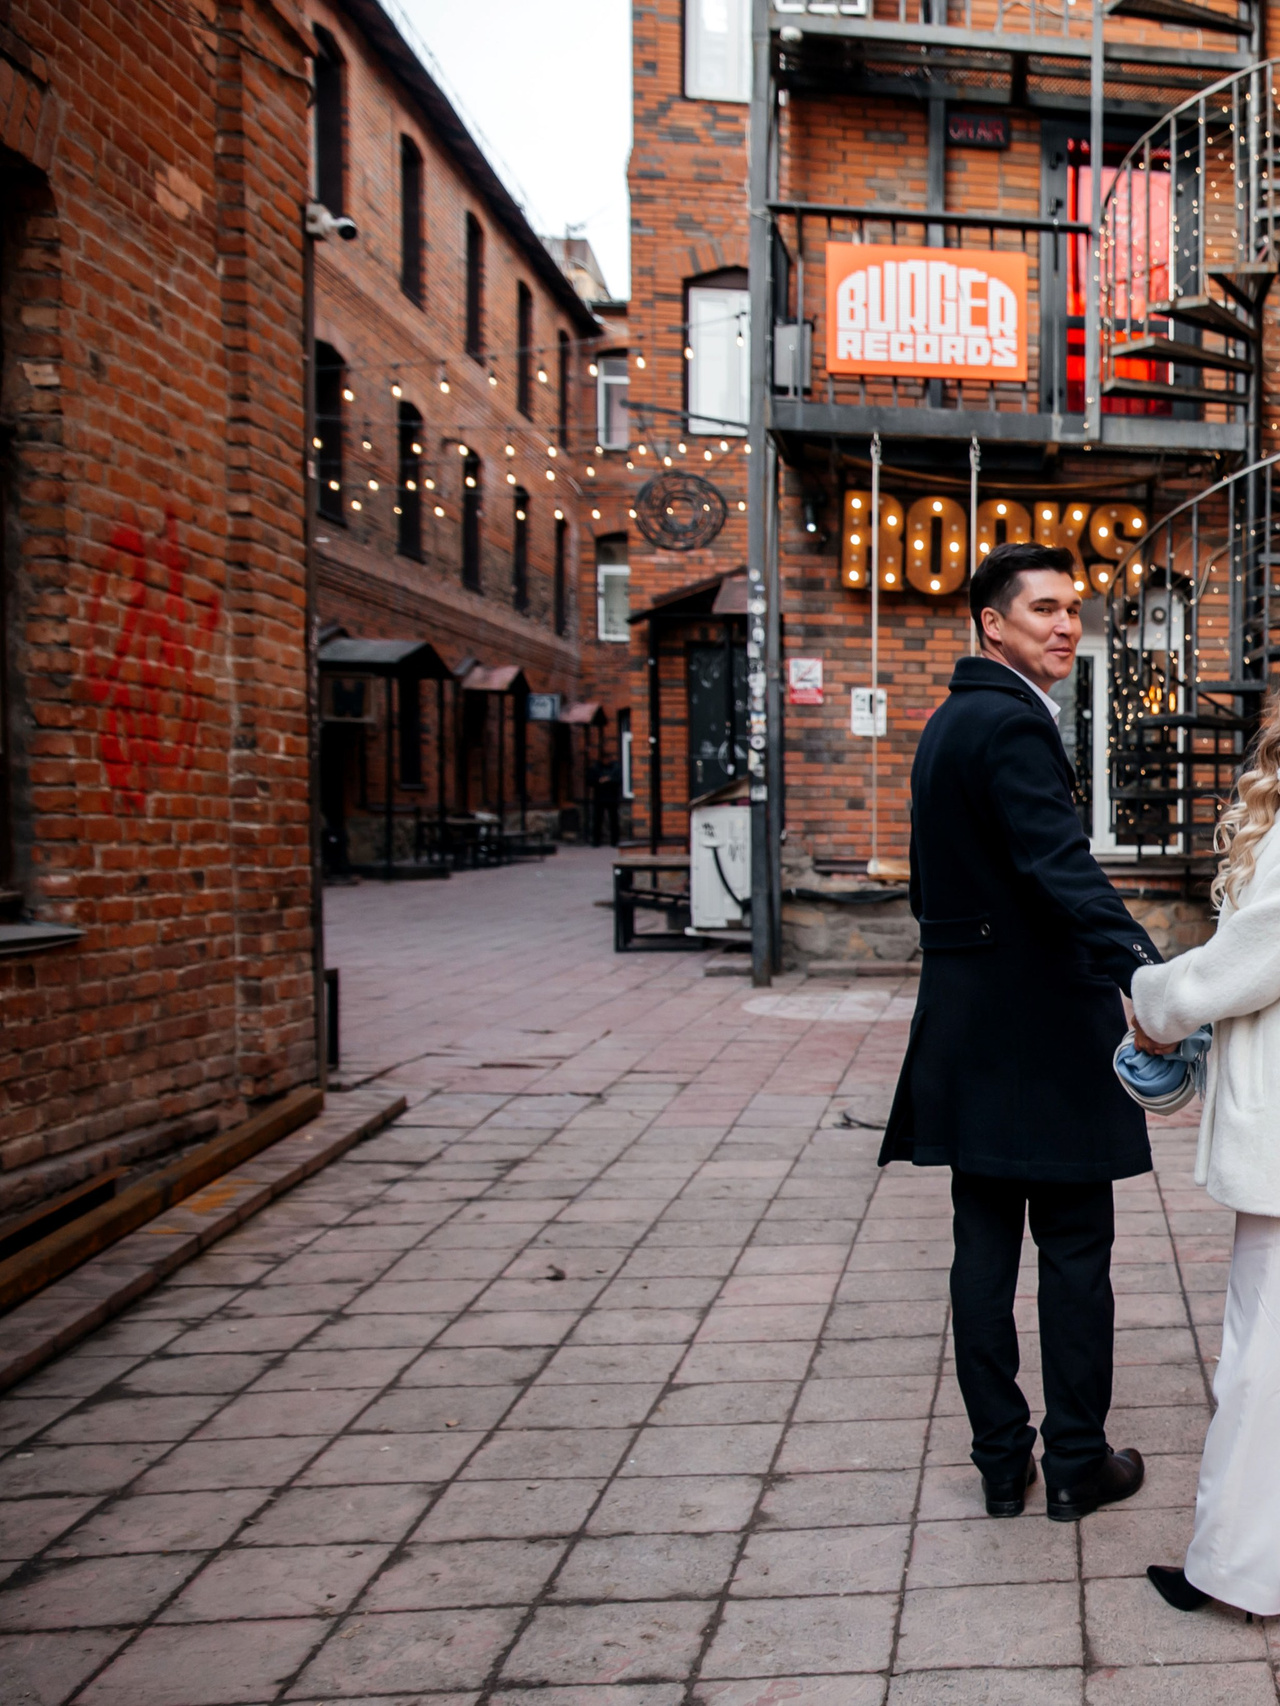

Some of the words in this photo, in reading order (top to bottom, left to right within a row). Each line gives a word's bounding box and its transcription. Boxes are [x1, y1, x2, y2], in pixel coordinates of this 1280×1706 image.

[949, 116, 974, 140] ON
[976, 120, 1005, 143] AIR
[836, 259, 1017, 338] BURGER
[836, 331, 1018, 367] RECORDS
